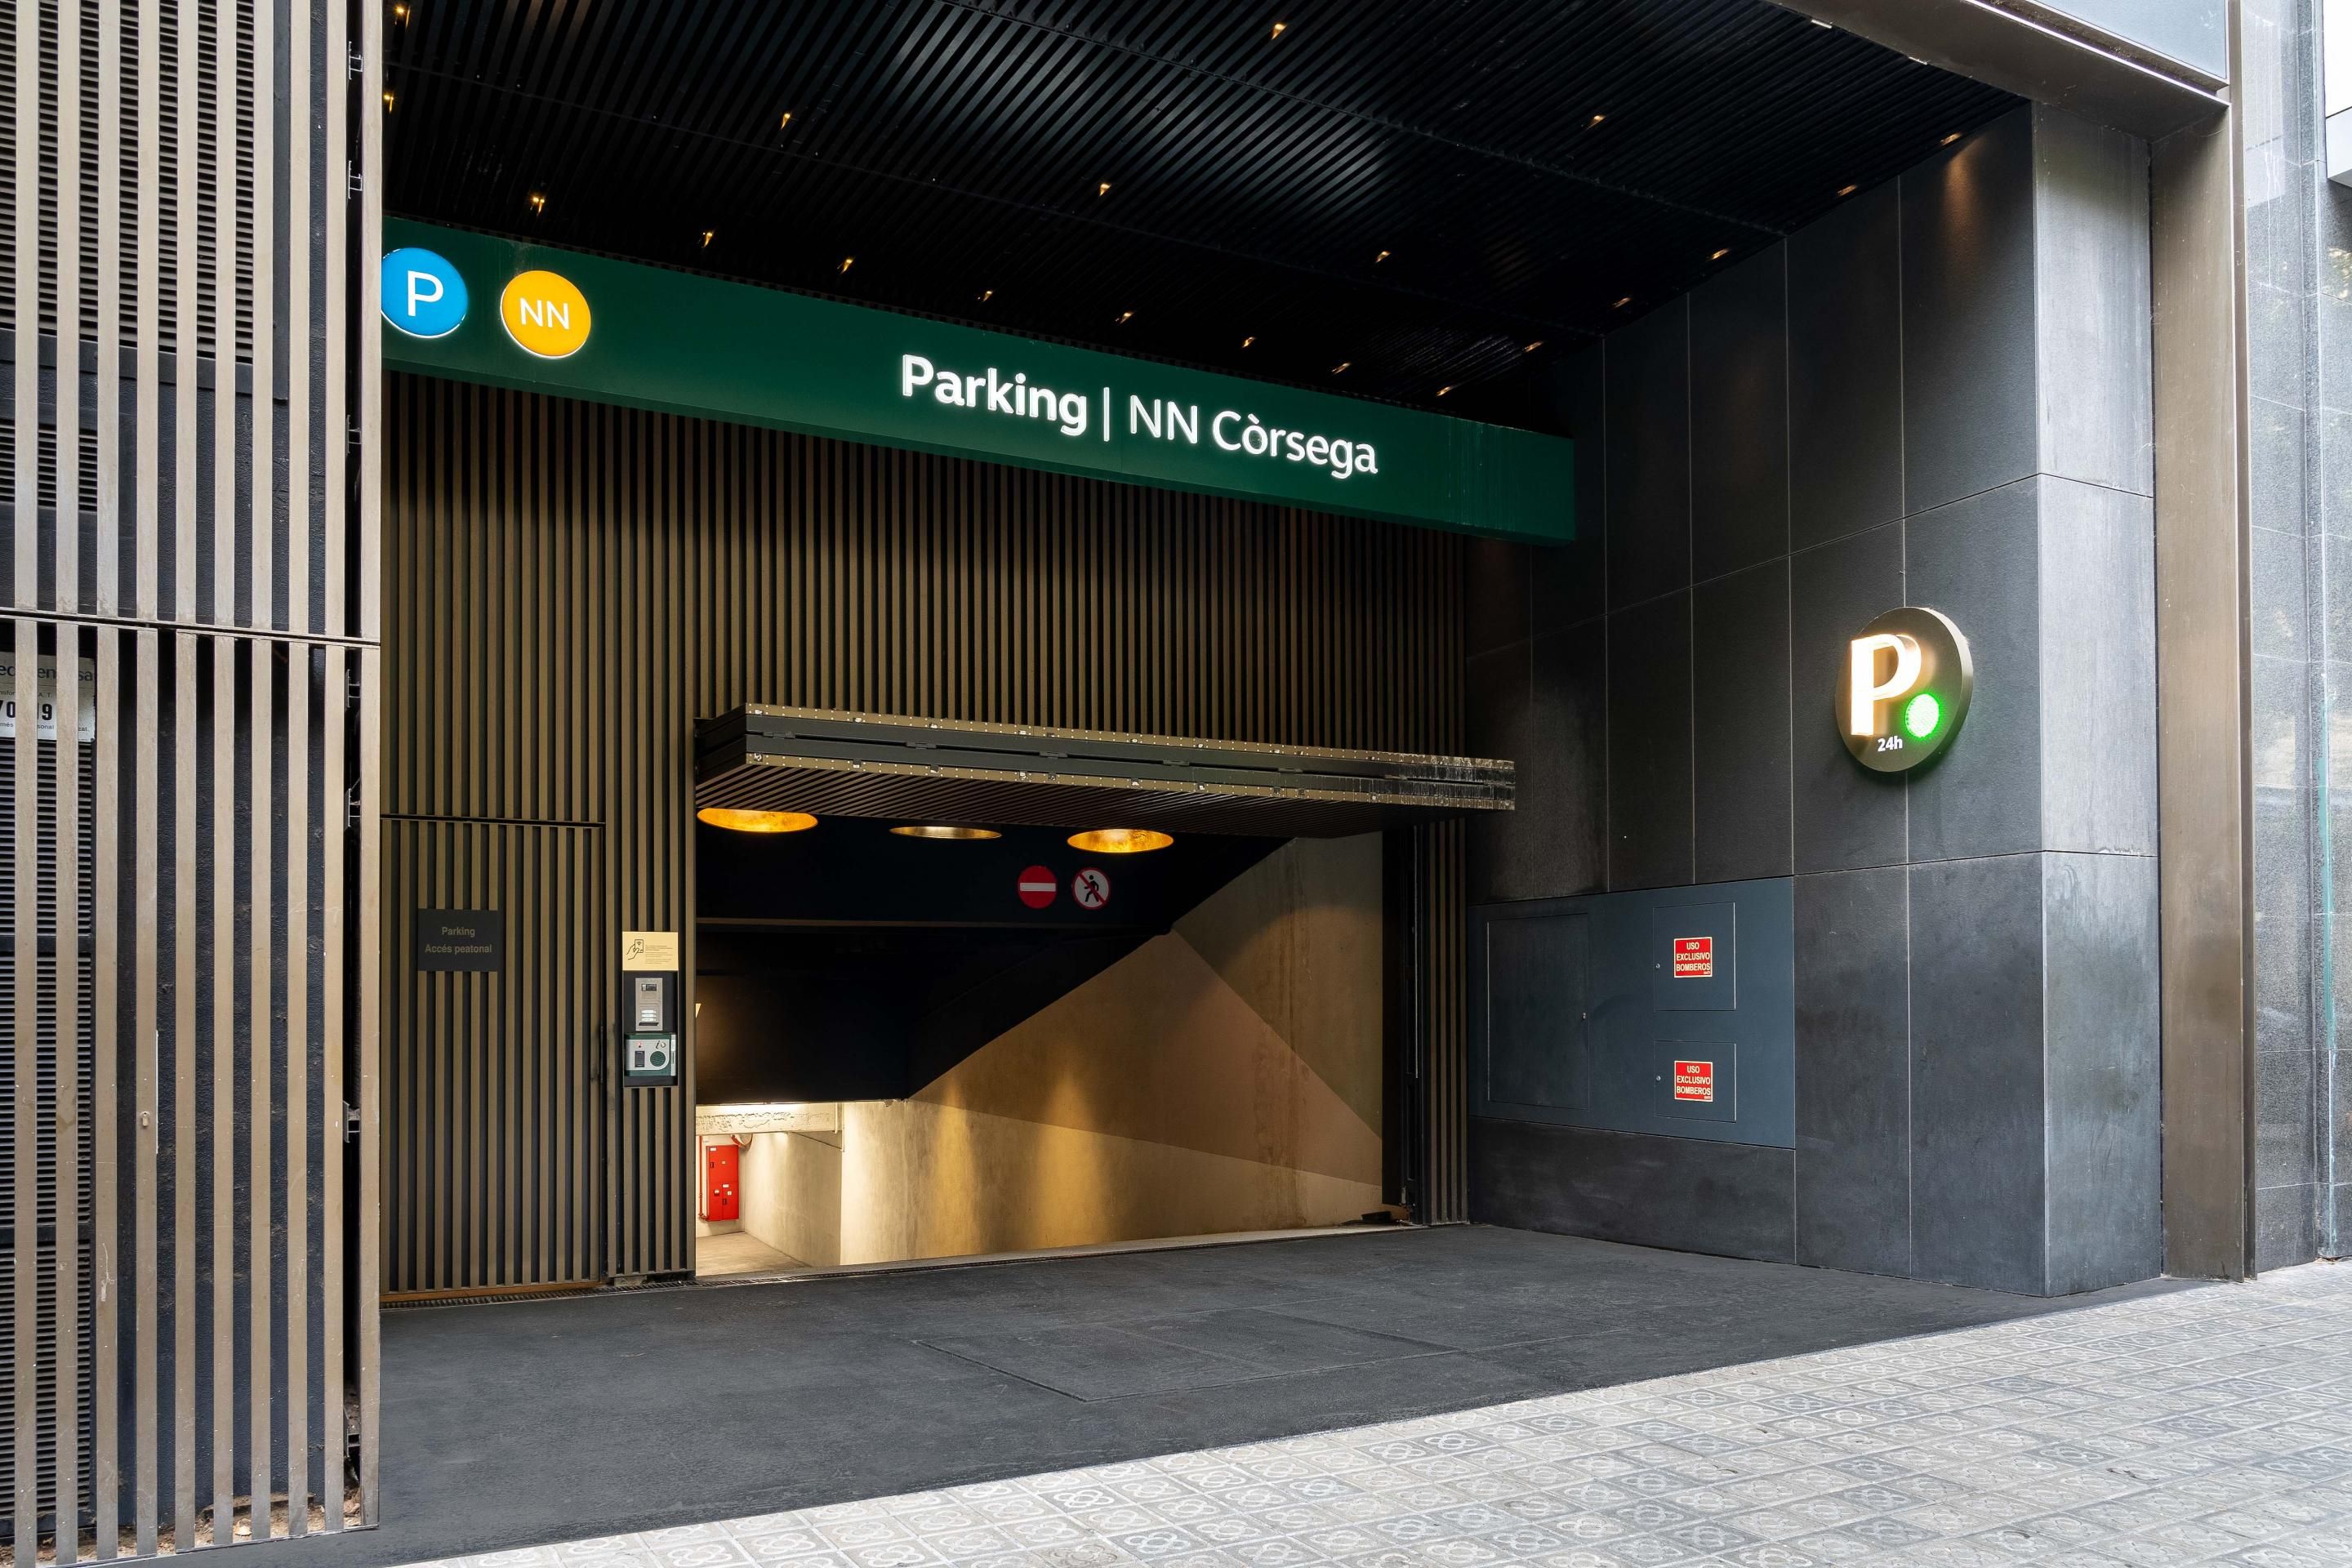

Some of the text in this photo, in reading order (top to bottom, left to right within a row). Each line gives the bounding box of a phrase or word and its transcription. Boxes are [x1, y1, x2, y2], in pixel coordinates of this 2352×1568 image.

[408, 270, 443, 316] P
[519, 296, 569, 330] NN
[902, 354, 1087, 436] Parking
[1129, 394, 1199, 444] NN
[1211, 410, 1379, 479] Còrsega
[1851, 633, 1922, 736] P
[1878, 735, 1903, 752] 24h
[442, 926, 475, 938] Parking
[454, 944, 492, 955] peatonal
[1686, 942, 1699, 950] USO
[1676, 952, 1710, 960] EXCLUSIVO
[1676, 963, 1710, 972] BOMBEROS
[1686, 1065, 1700, 1074] USO
[1677, 1075, 1711, 1085] EXCLUSIVO
[1677, 1085, 1711, 1095] BOMBEROS
